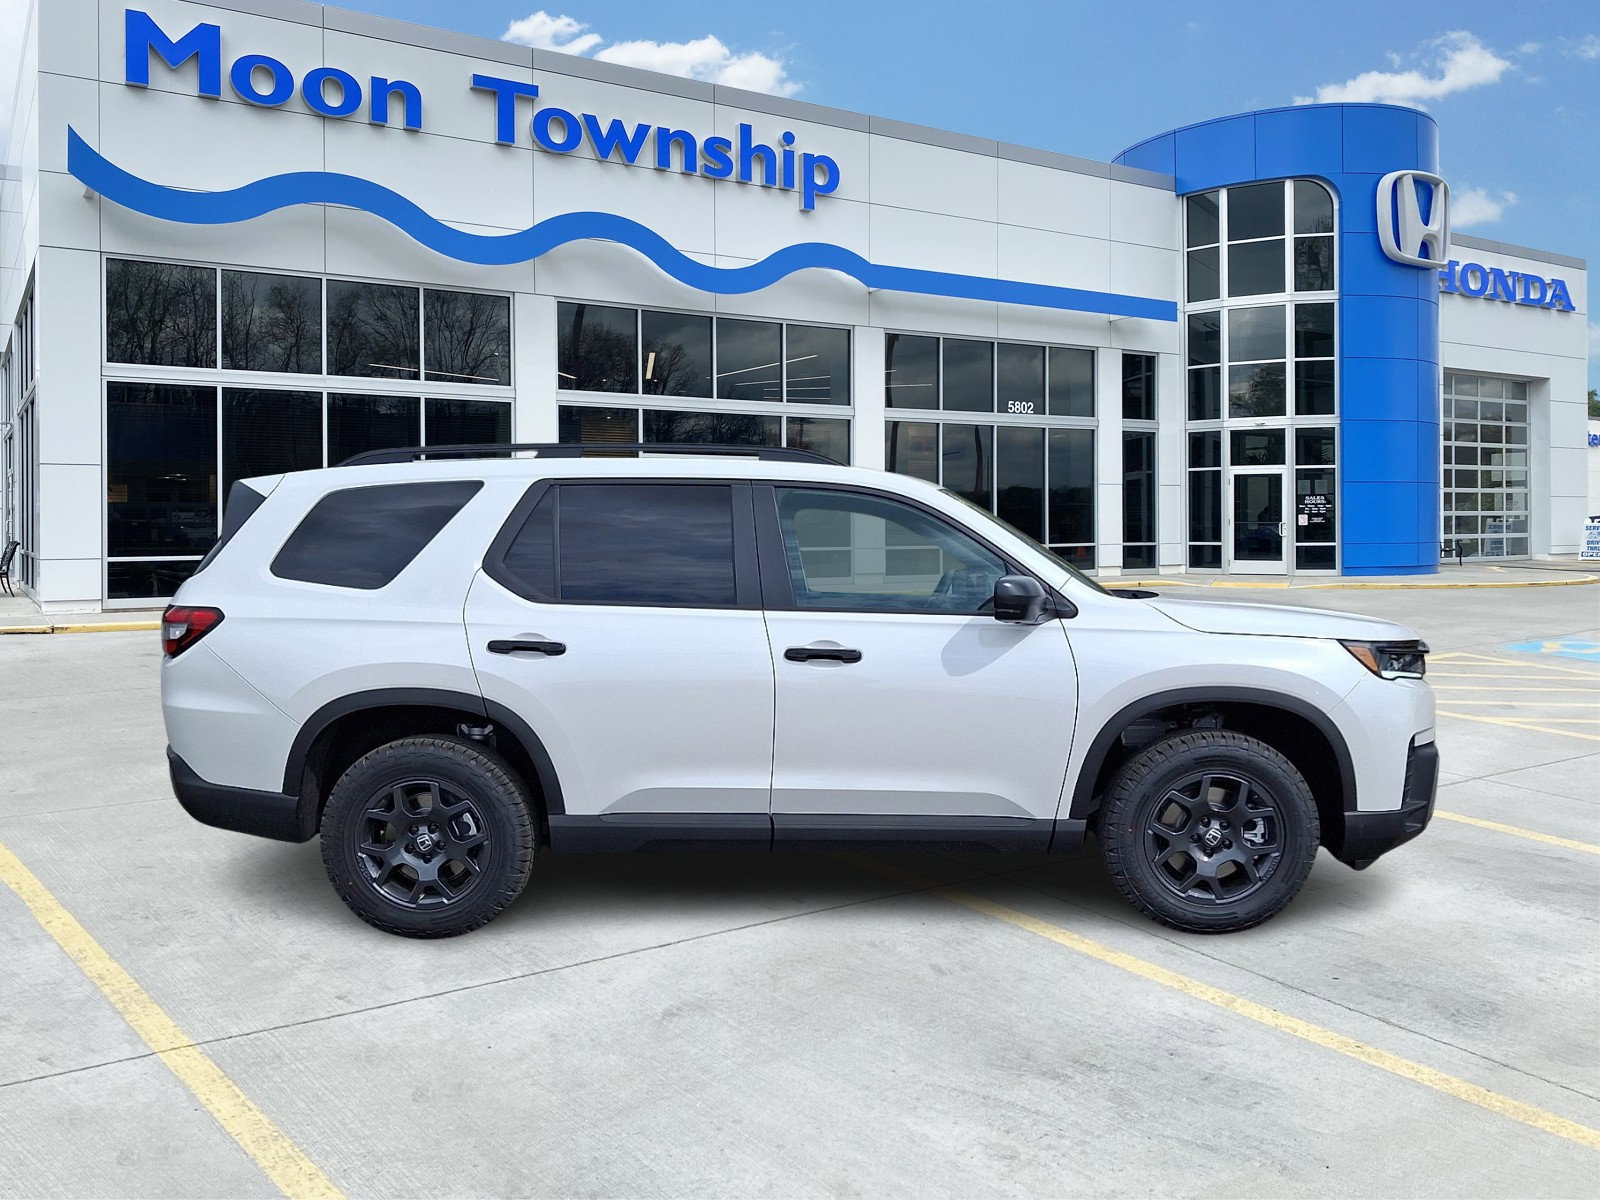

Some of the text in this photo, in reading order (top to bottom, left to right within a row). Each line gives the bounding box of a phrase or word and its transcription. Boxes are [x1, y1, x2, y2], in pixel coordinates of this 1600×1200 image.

[124, 8, 841, 213] Moon Township
[1438, 259, 1576, 312] HONDA
[1007, 400, 1034, 414] 5802
